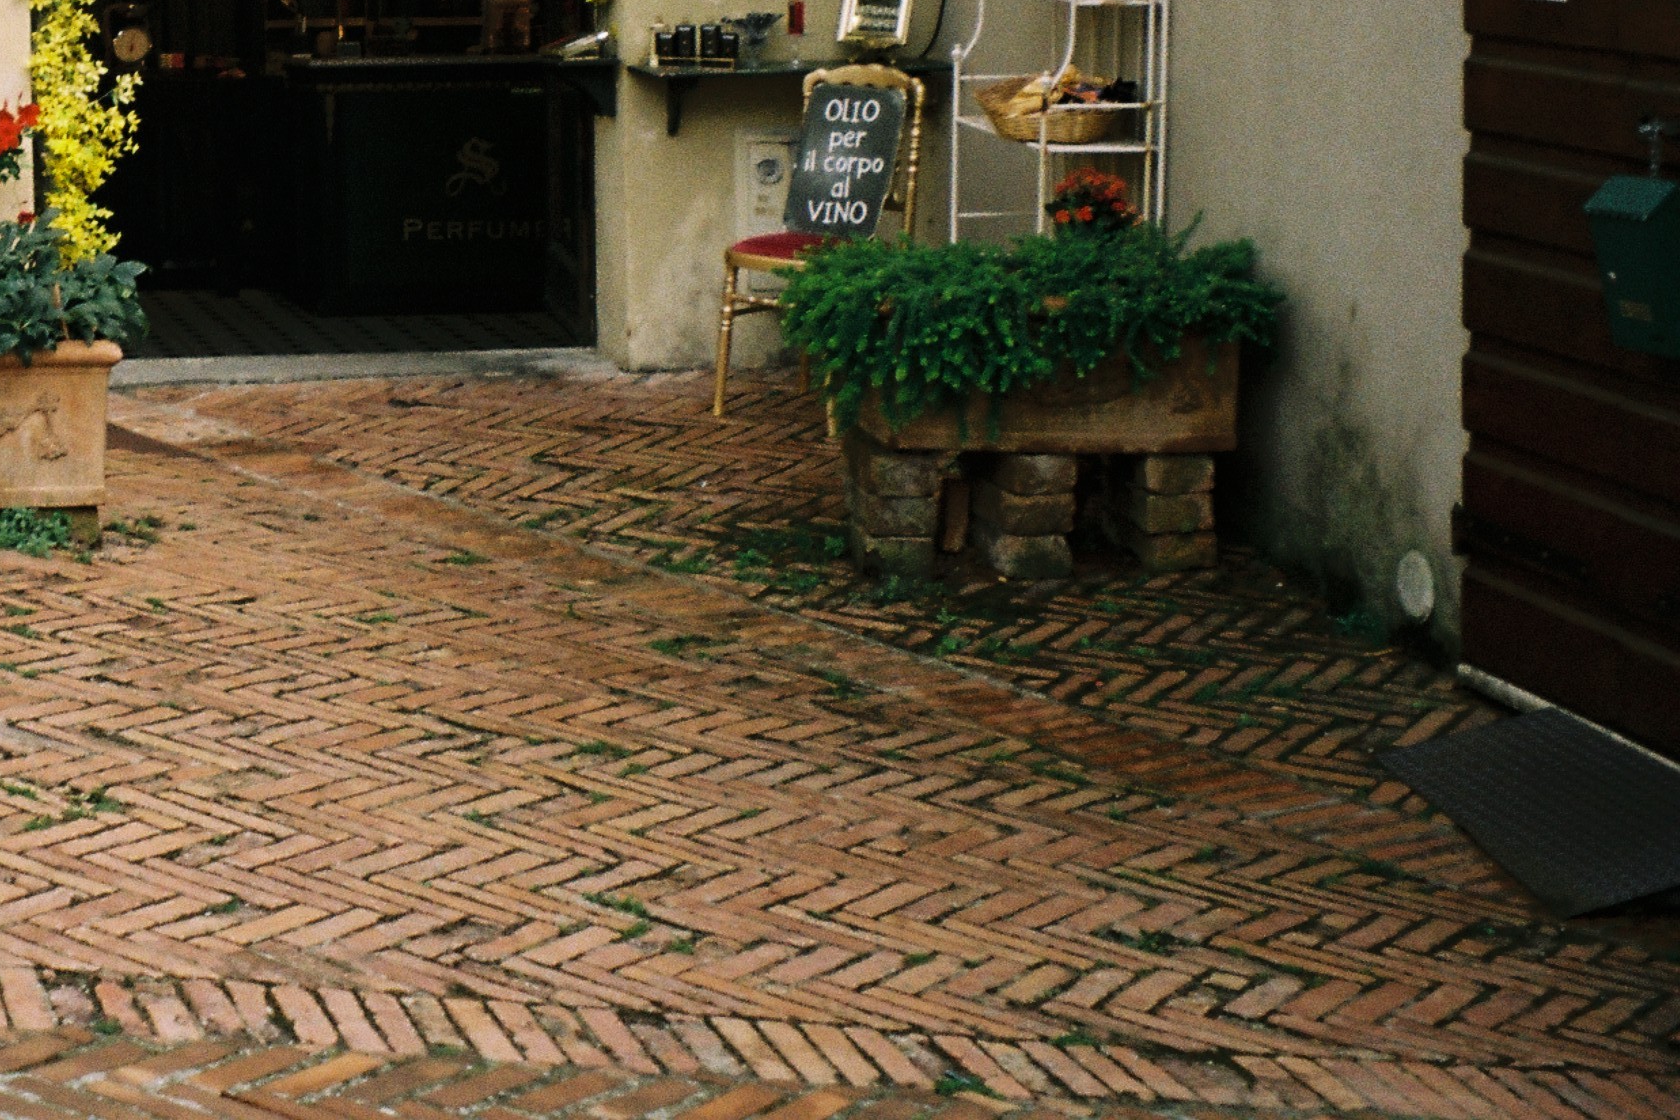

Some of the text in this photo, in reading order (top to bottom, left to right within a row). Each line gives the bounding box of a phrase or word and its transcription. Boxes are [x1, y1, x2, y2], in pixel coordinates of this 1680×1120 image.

[825, 99, 881, 123] OLIO
[829, 131, 867, 152] per
[804, 149, 884, 179] il corpo
[831, 176, 851, 198] al
[807, 200, 868, 224] VINO
